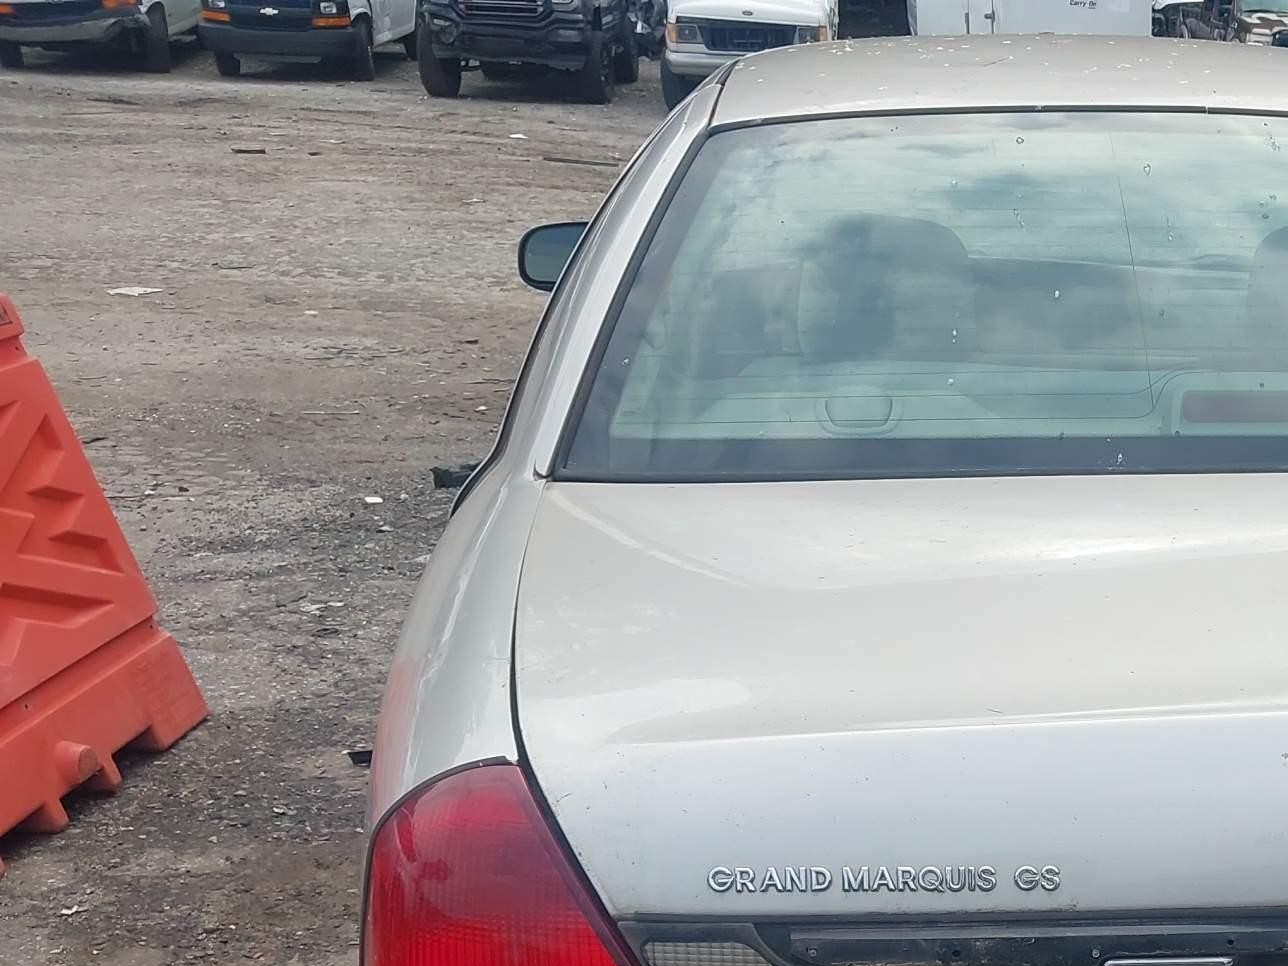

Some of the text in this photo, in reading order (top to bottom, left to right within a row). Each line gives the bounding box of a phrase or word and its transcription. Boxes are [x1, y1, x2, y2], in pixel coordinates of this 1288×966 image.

[707, 866, 1061, 893] GRAND MARQUIS GS
